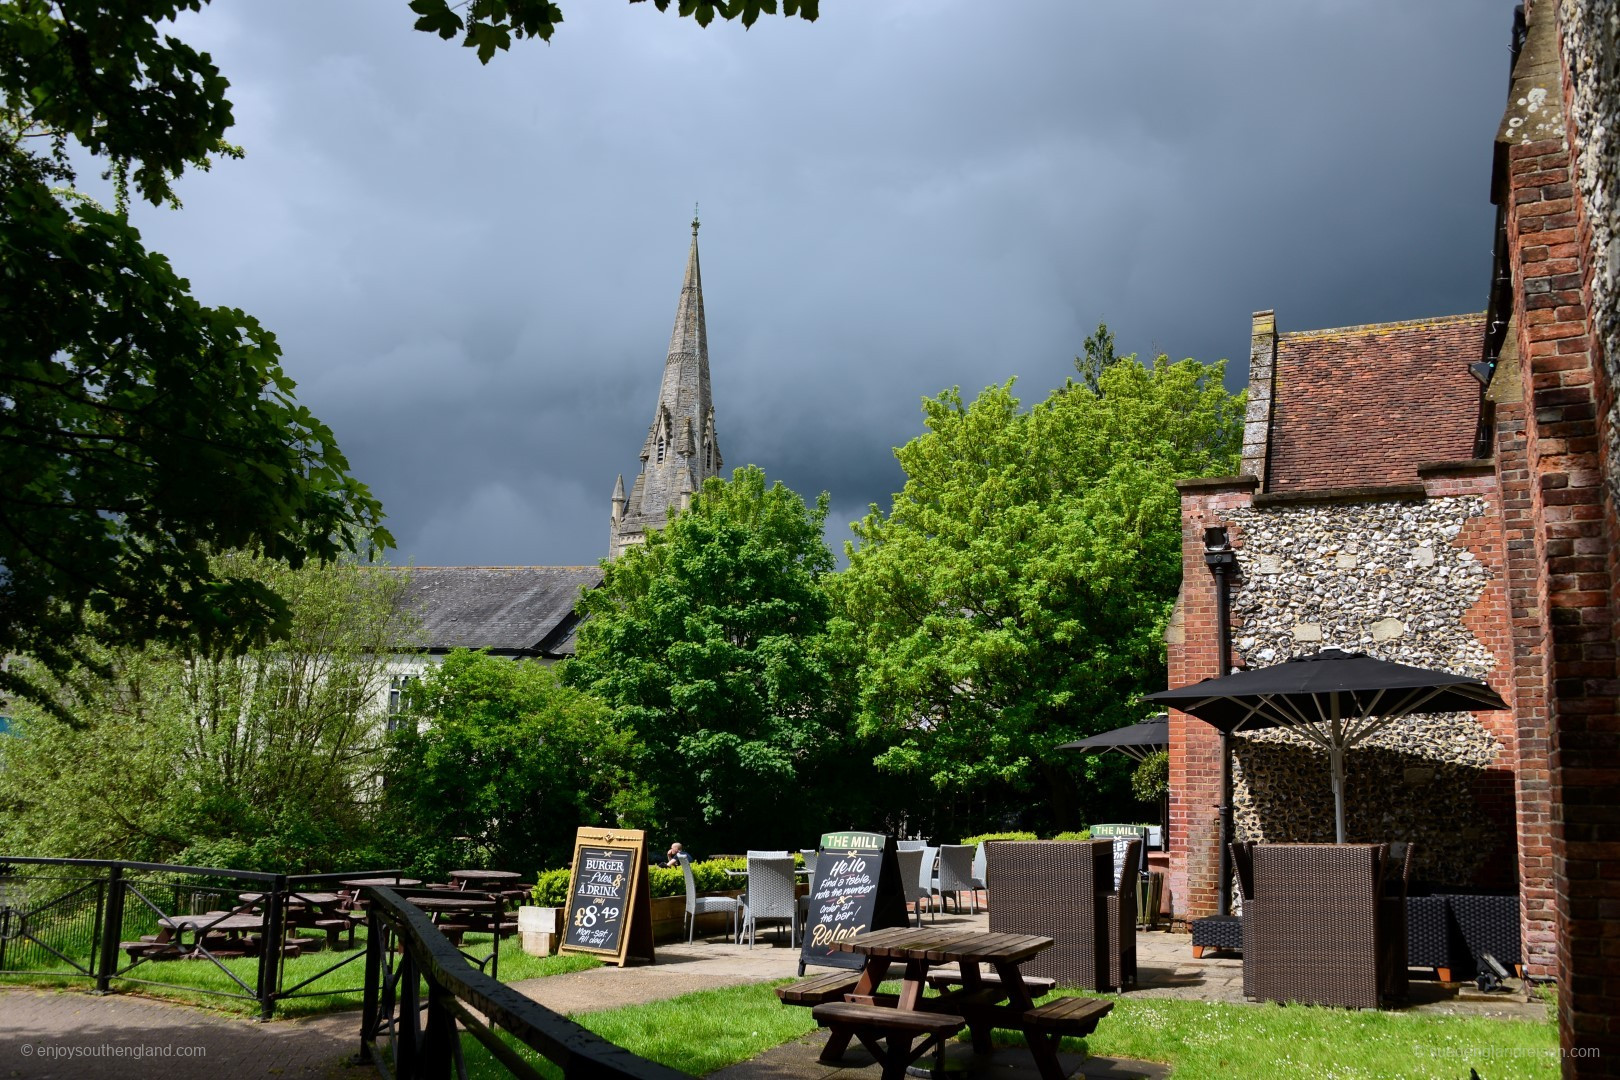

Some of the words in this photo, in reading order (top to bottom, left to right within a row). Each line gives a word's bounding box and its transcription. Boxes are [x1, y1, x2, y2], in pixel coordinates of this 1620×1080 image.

[1096, 827, 1114, 835] THE
[1116, 827, 1139, 836] MILL
[828, 835, 849, 847] THE
[851, 836, 878, 849] MILL
[585, 860, 625, 872] BURGER
[830, 858, 866, 877] Hello
[612, 874, 626, 889] &
[820, 877, 838, 890] Find
[837, 878, 845, 887] a
[577, 883, 586, 894] A
[587, 885, 618, 897] DRINK
[814, 889, 831, 900] note
[831, 887, 843, 897] the
[843, 884, 876, 896] number
[837, 895, 852, 905] &
[841, 900, 854, 911] at
[820, 913, 833, 924] the
[811, 923, 866, 948] Relax
